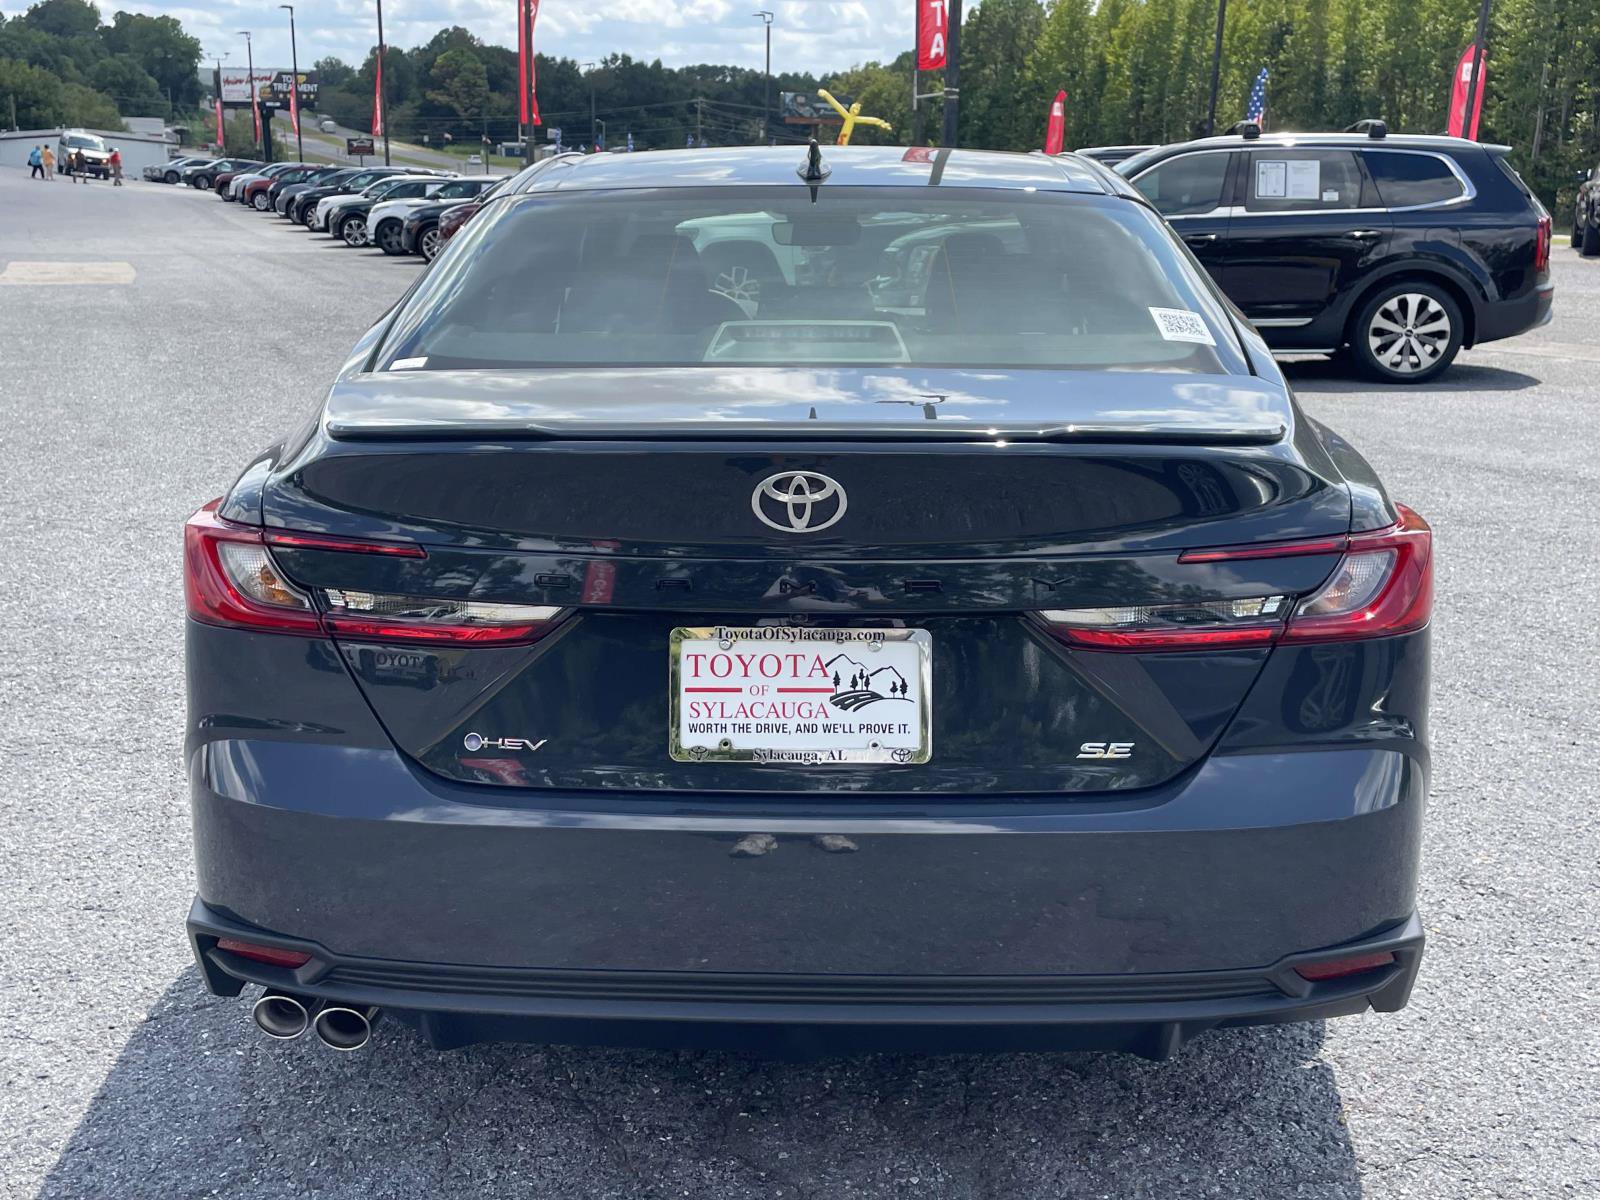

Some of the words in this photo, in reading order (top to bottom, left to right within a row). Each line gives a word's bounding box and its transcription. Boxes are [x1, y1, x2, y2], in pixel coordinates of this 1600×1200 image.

[272, 82, 319, 93] TREAMENT
[715, 627, 885, 643] ToyotaOfSylacauga.com
[686, 653, 830, 678] TOYOTA
[749, 684, 770, 696] OF
[689, 701, 829, 719] SYLACAUGA
[688, 722, 727, 734] WORTH
[731, 722, 752, 734] THE
[755, 722, 791, 735] DRIVE,
[795, 723, 818, 734] AND
[822, 723, 855, 734] WE'LL
[859, 723, 894, 734] PROVE
[898, 723, 911, 735] IT.
[753, 748, 822, 764] Sylacauga,
[827, 749, 847, 761] AL
[1076, 742, 1135, 759] SE
